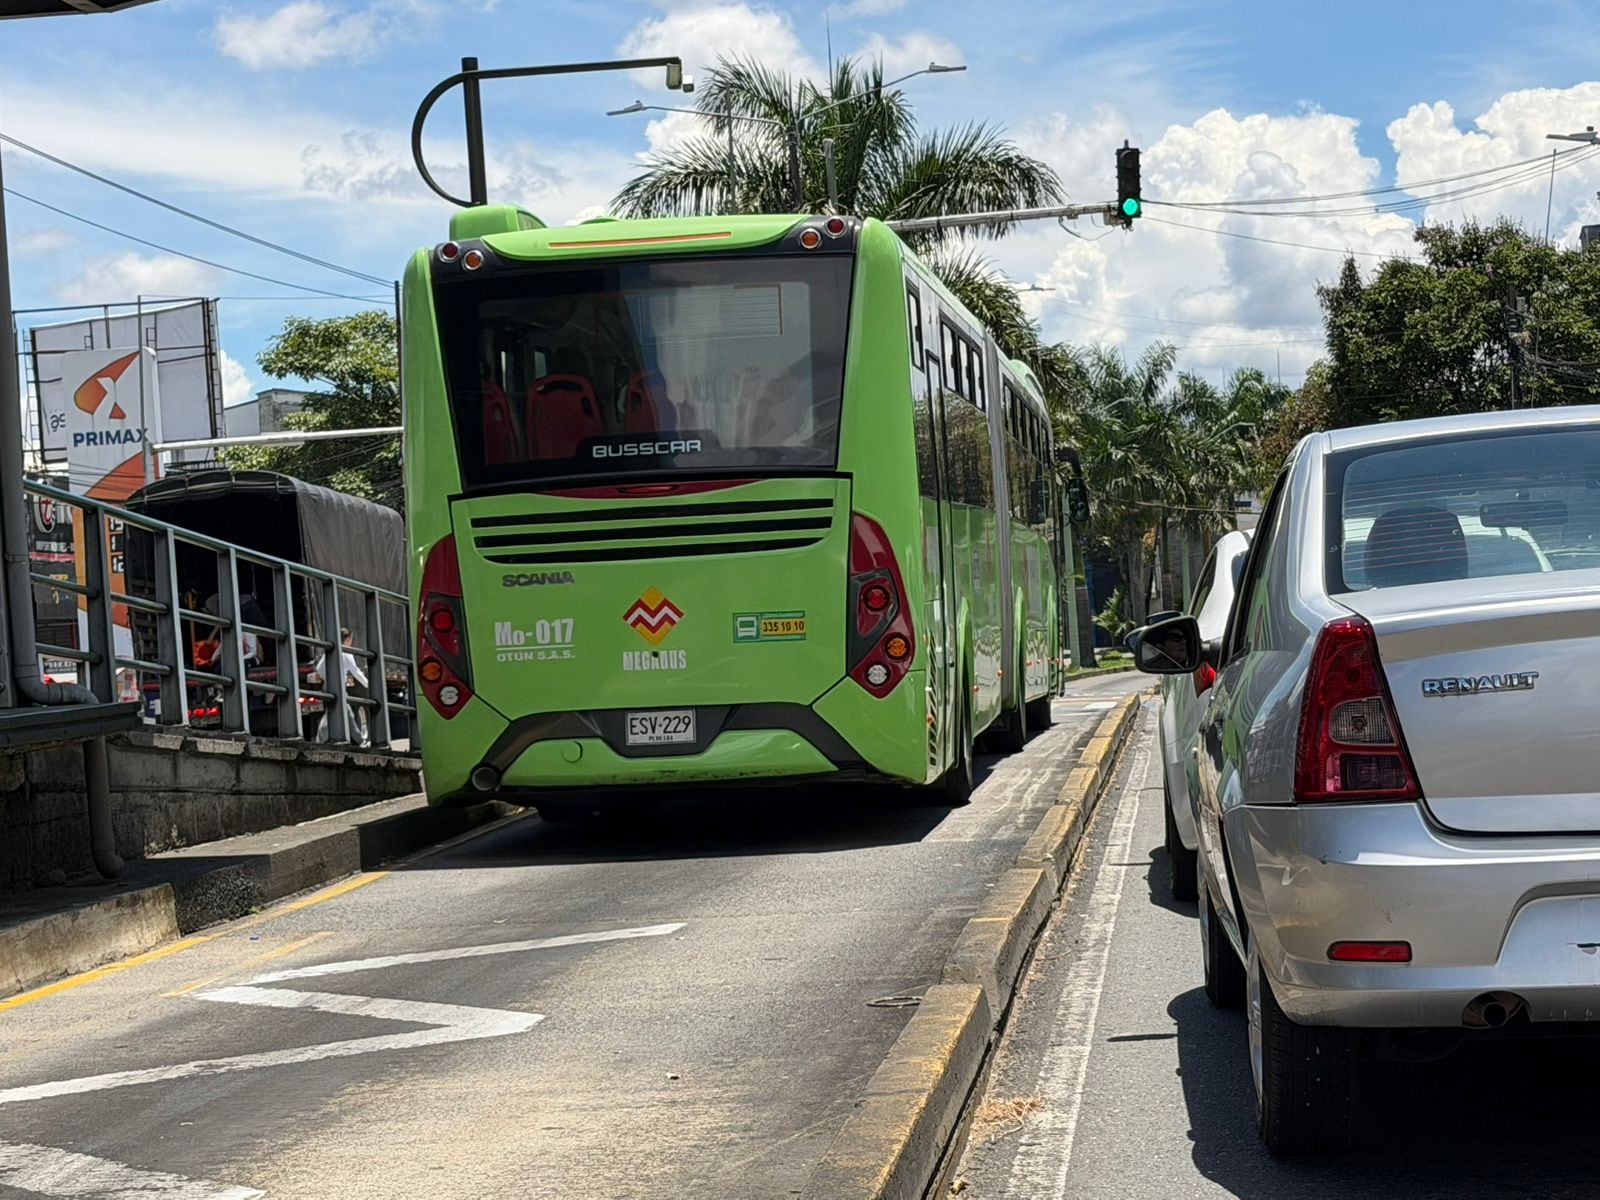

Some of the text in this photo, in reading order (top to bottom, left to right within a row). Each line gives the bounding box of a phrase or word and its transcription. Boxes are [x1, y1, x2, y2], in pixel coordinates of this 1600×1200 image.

[73, 428, 149, 447] PRIMAX
[592, 439, 702, 458] BUSSCAR
[502, 571, 575, 587] SCANIA
[494, 618, 574, 646] Mo-017
[762, 620, 805, 632] 335 10 10
[497, 649, 576, 662] OTUN S.A.S.
[1422, 671, 1540, 697] RENAULT
